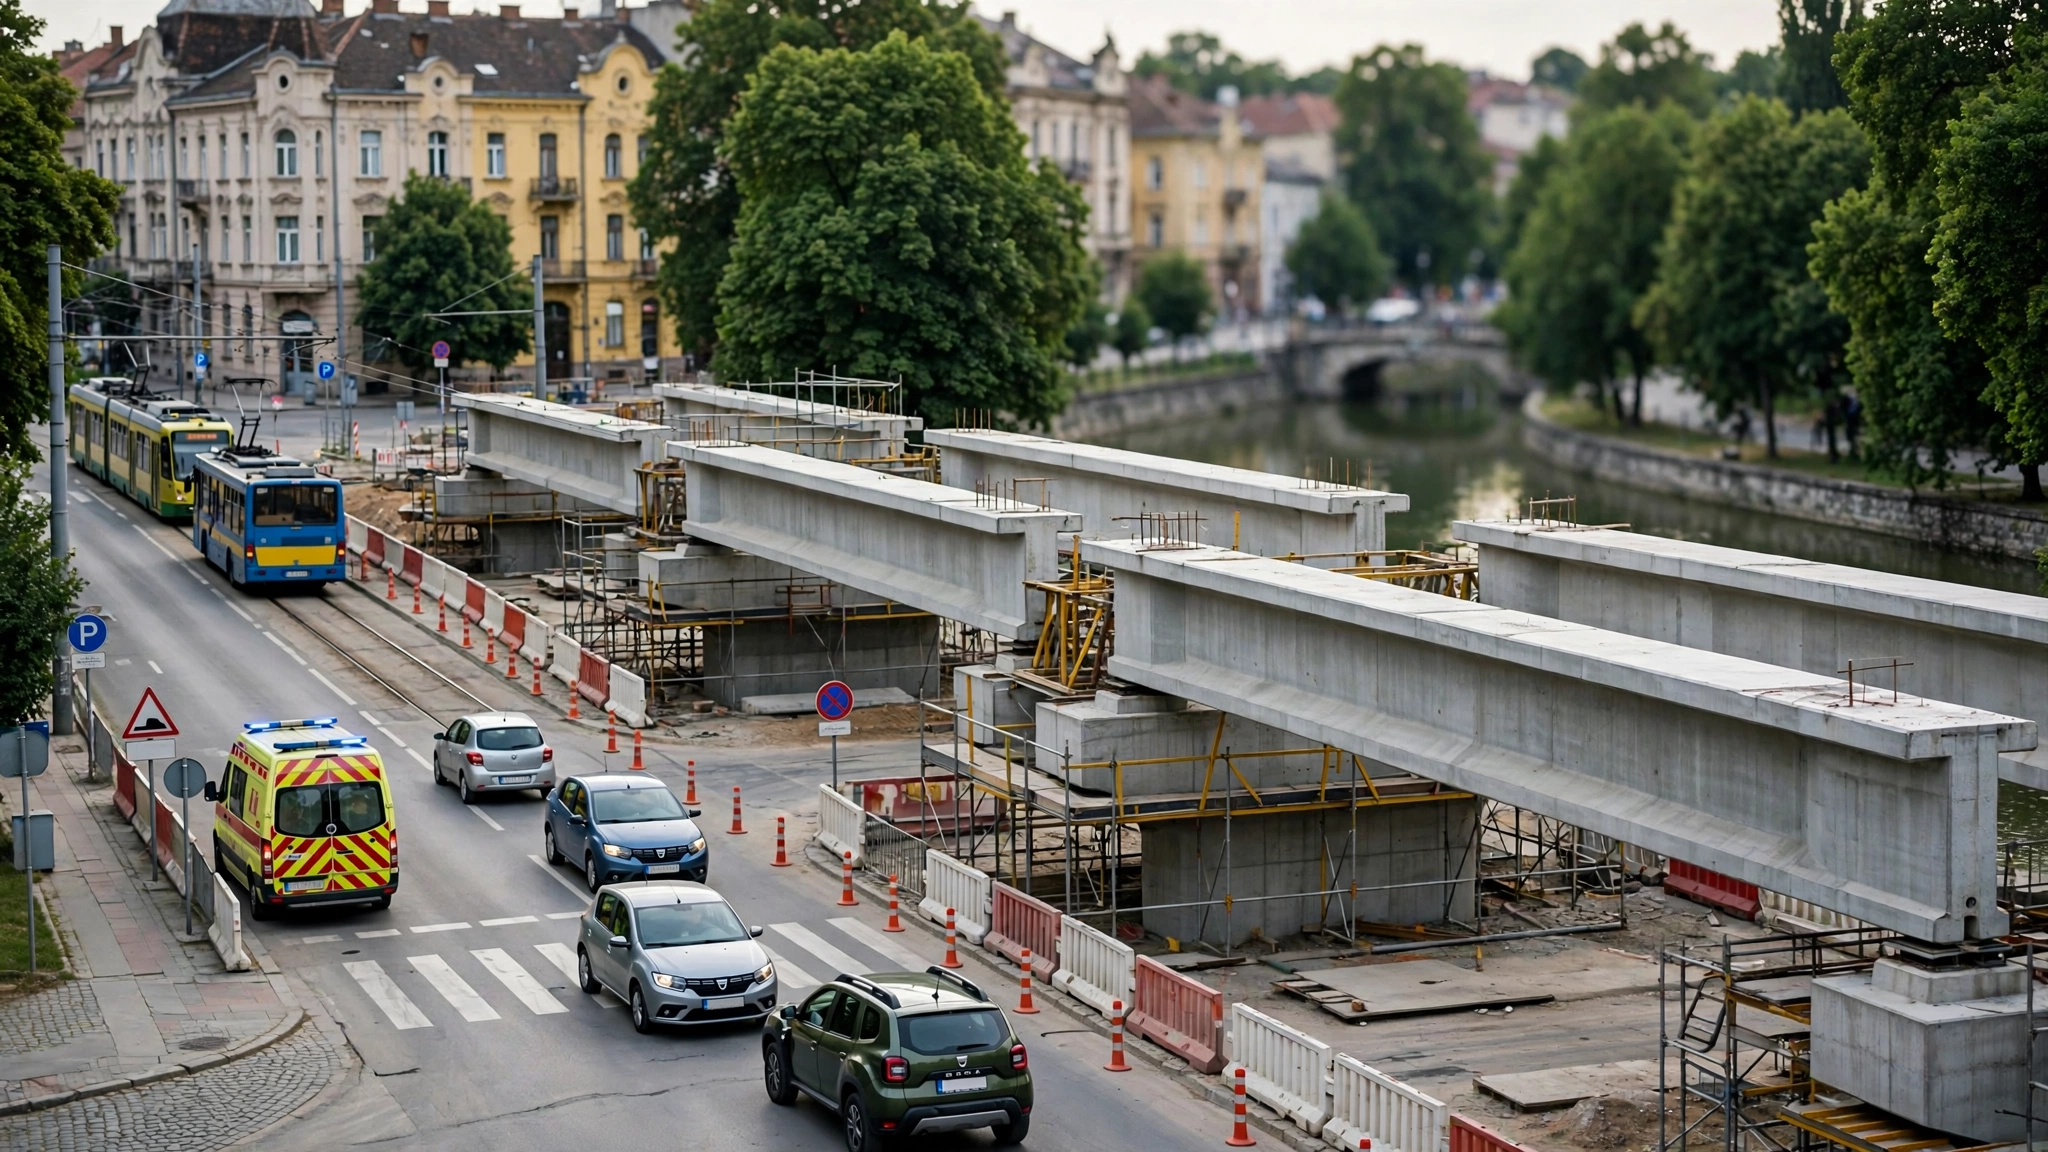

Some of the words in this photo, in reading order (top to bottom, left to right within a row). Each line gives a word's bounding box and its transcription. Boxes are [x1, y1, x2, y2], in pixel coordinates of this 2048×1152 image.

[197, 354, 205, 366] P
[322, 364, 331, 376] P
[80, 621, 98, 646] P
